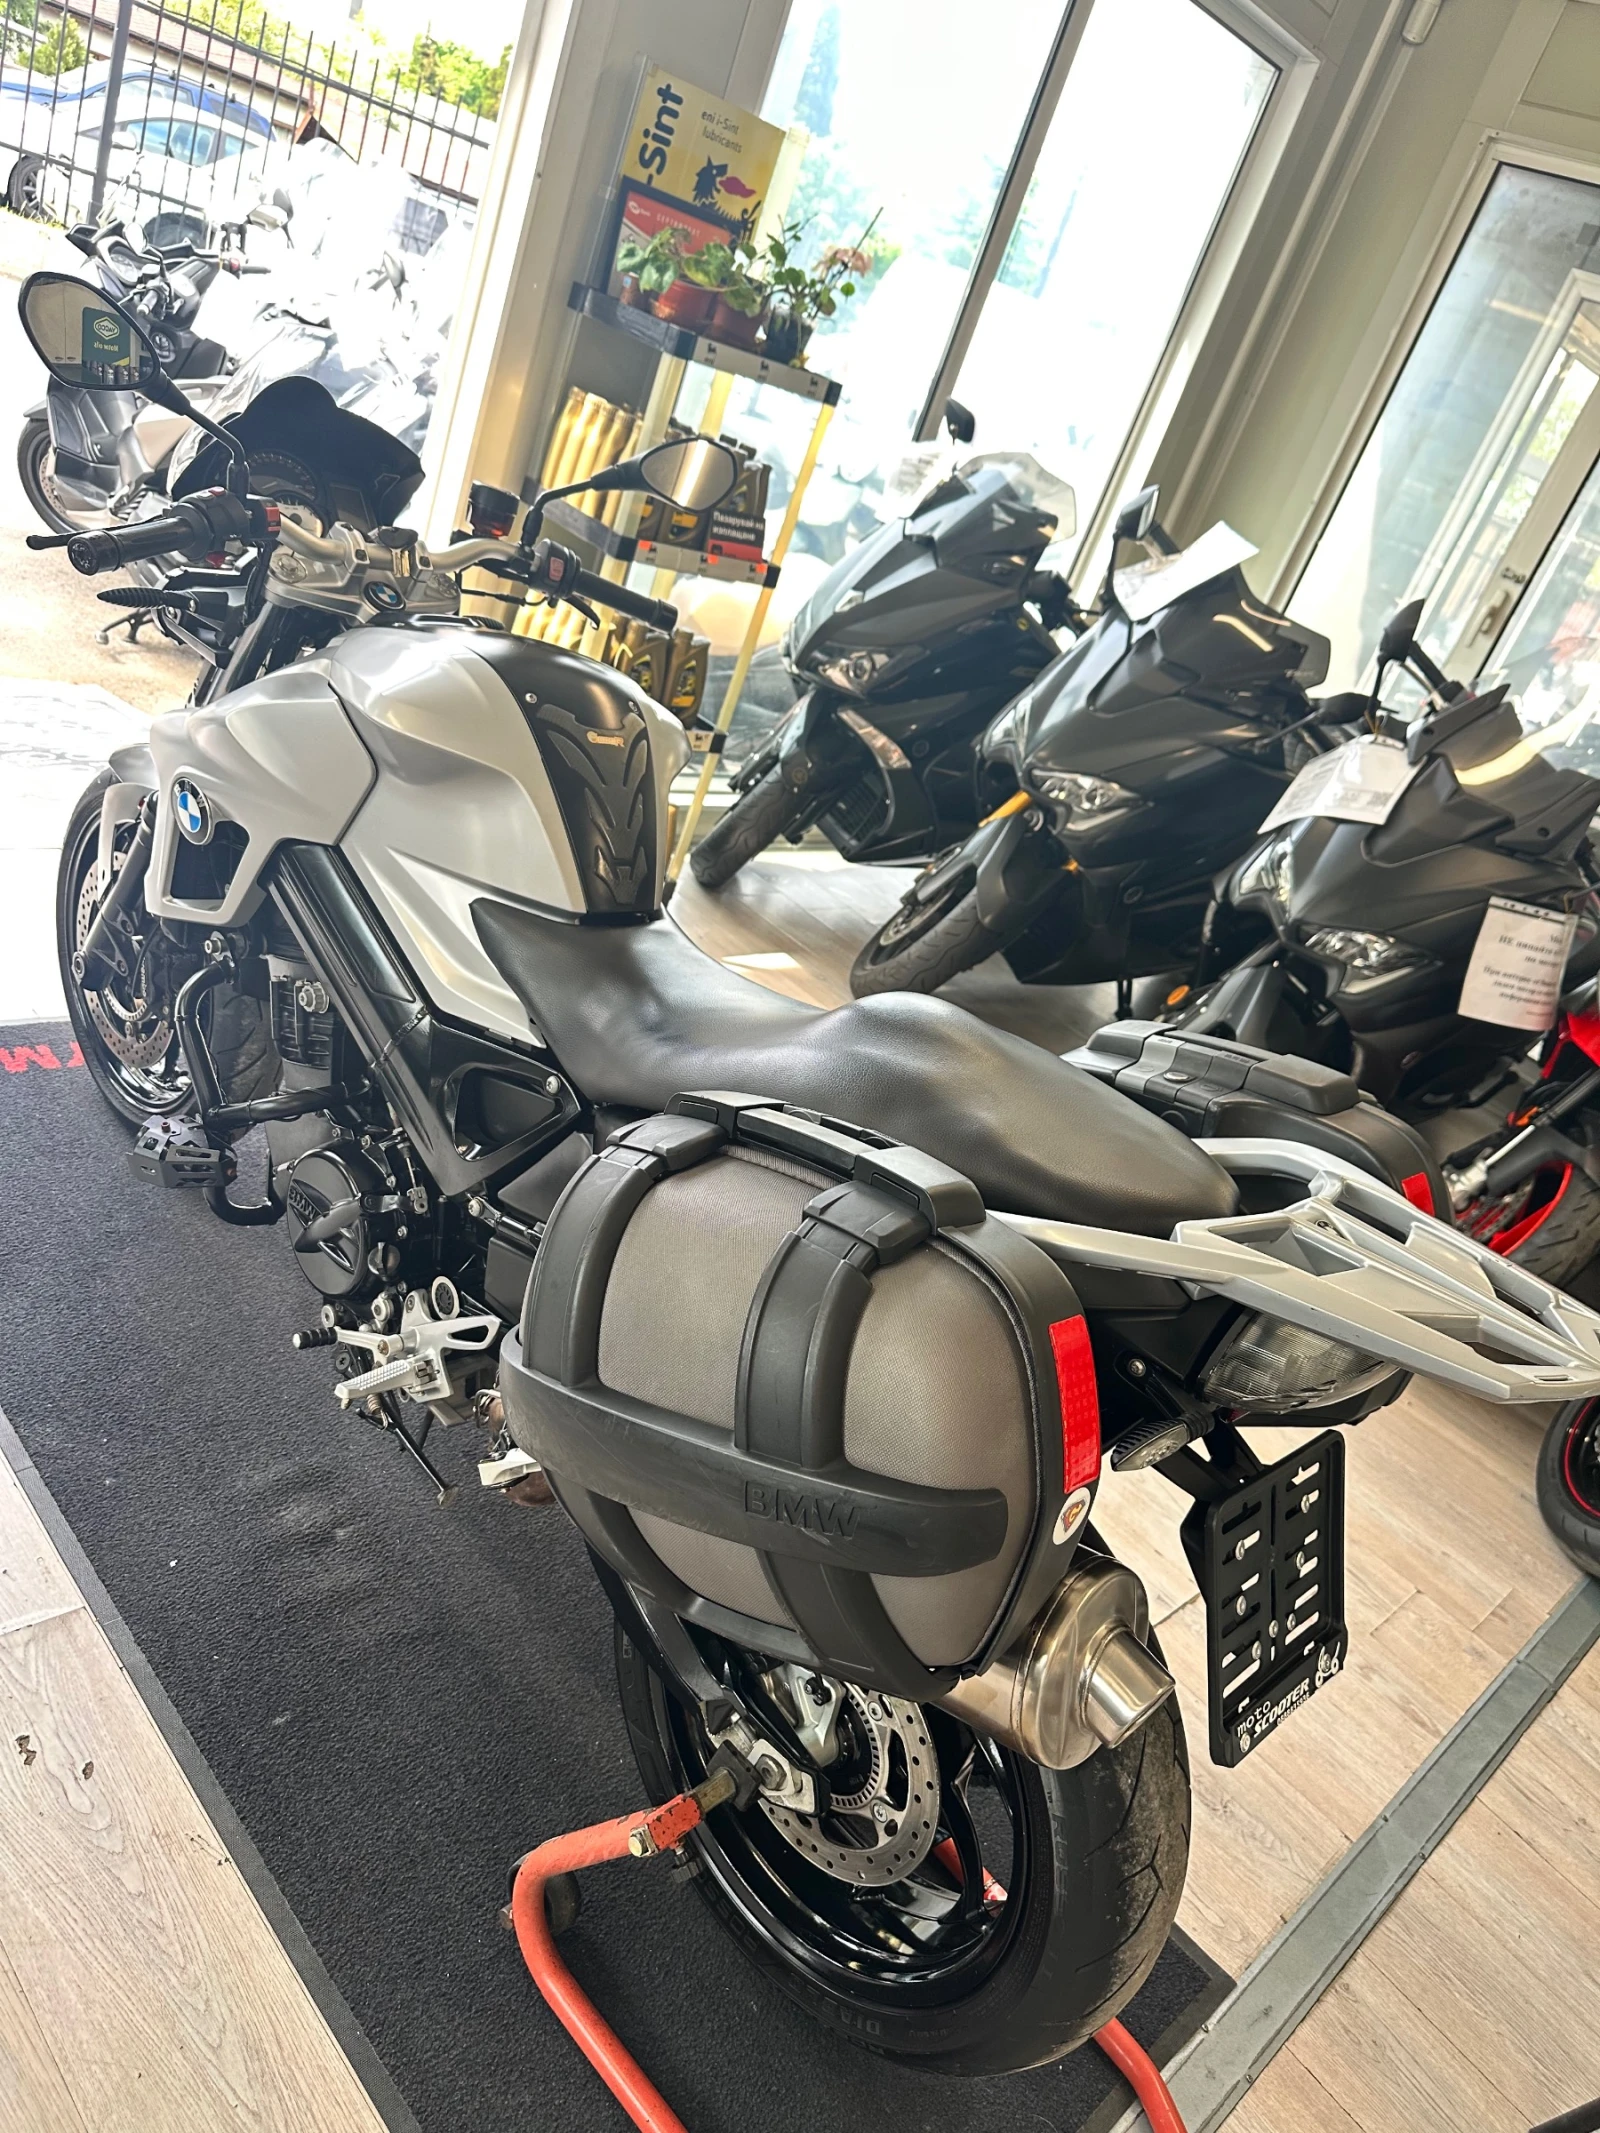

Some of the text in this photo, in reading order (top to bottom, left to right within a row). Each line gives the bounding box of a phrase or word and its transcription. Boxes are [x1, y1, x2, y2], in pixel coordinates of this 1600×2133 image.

[701, 110, 740, 136] eni i-Sint
[702, 125, 742, 153] lubricants
[713, 511, 754, 528] Пазарувай
[289, 1186, 317, 1220] BMW
[744, 1480, 860, 1541] BMW
[1236, 1700, 1271, 1738] moto
[1253, 1677, 1310, 1738] SCOOTER
